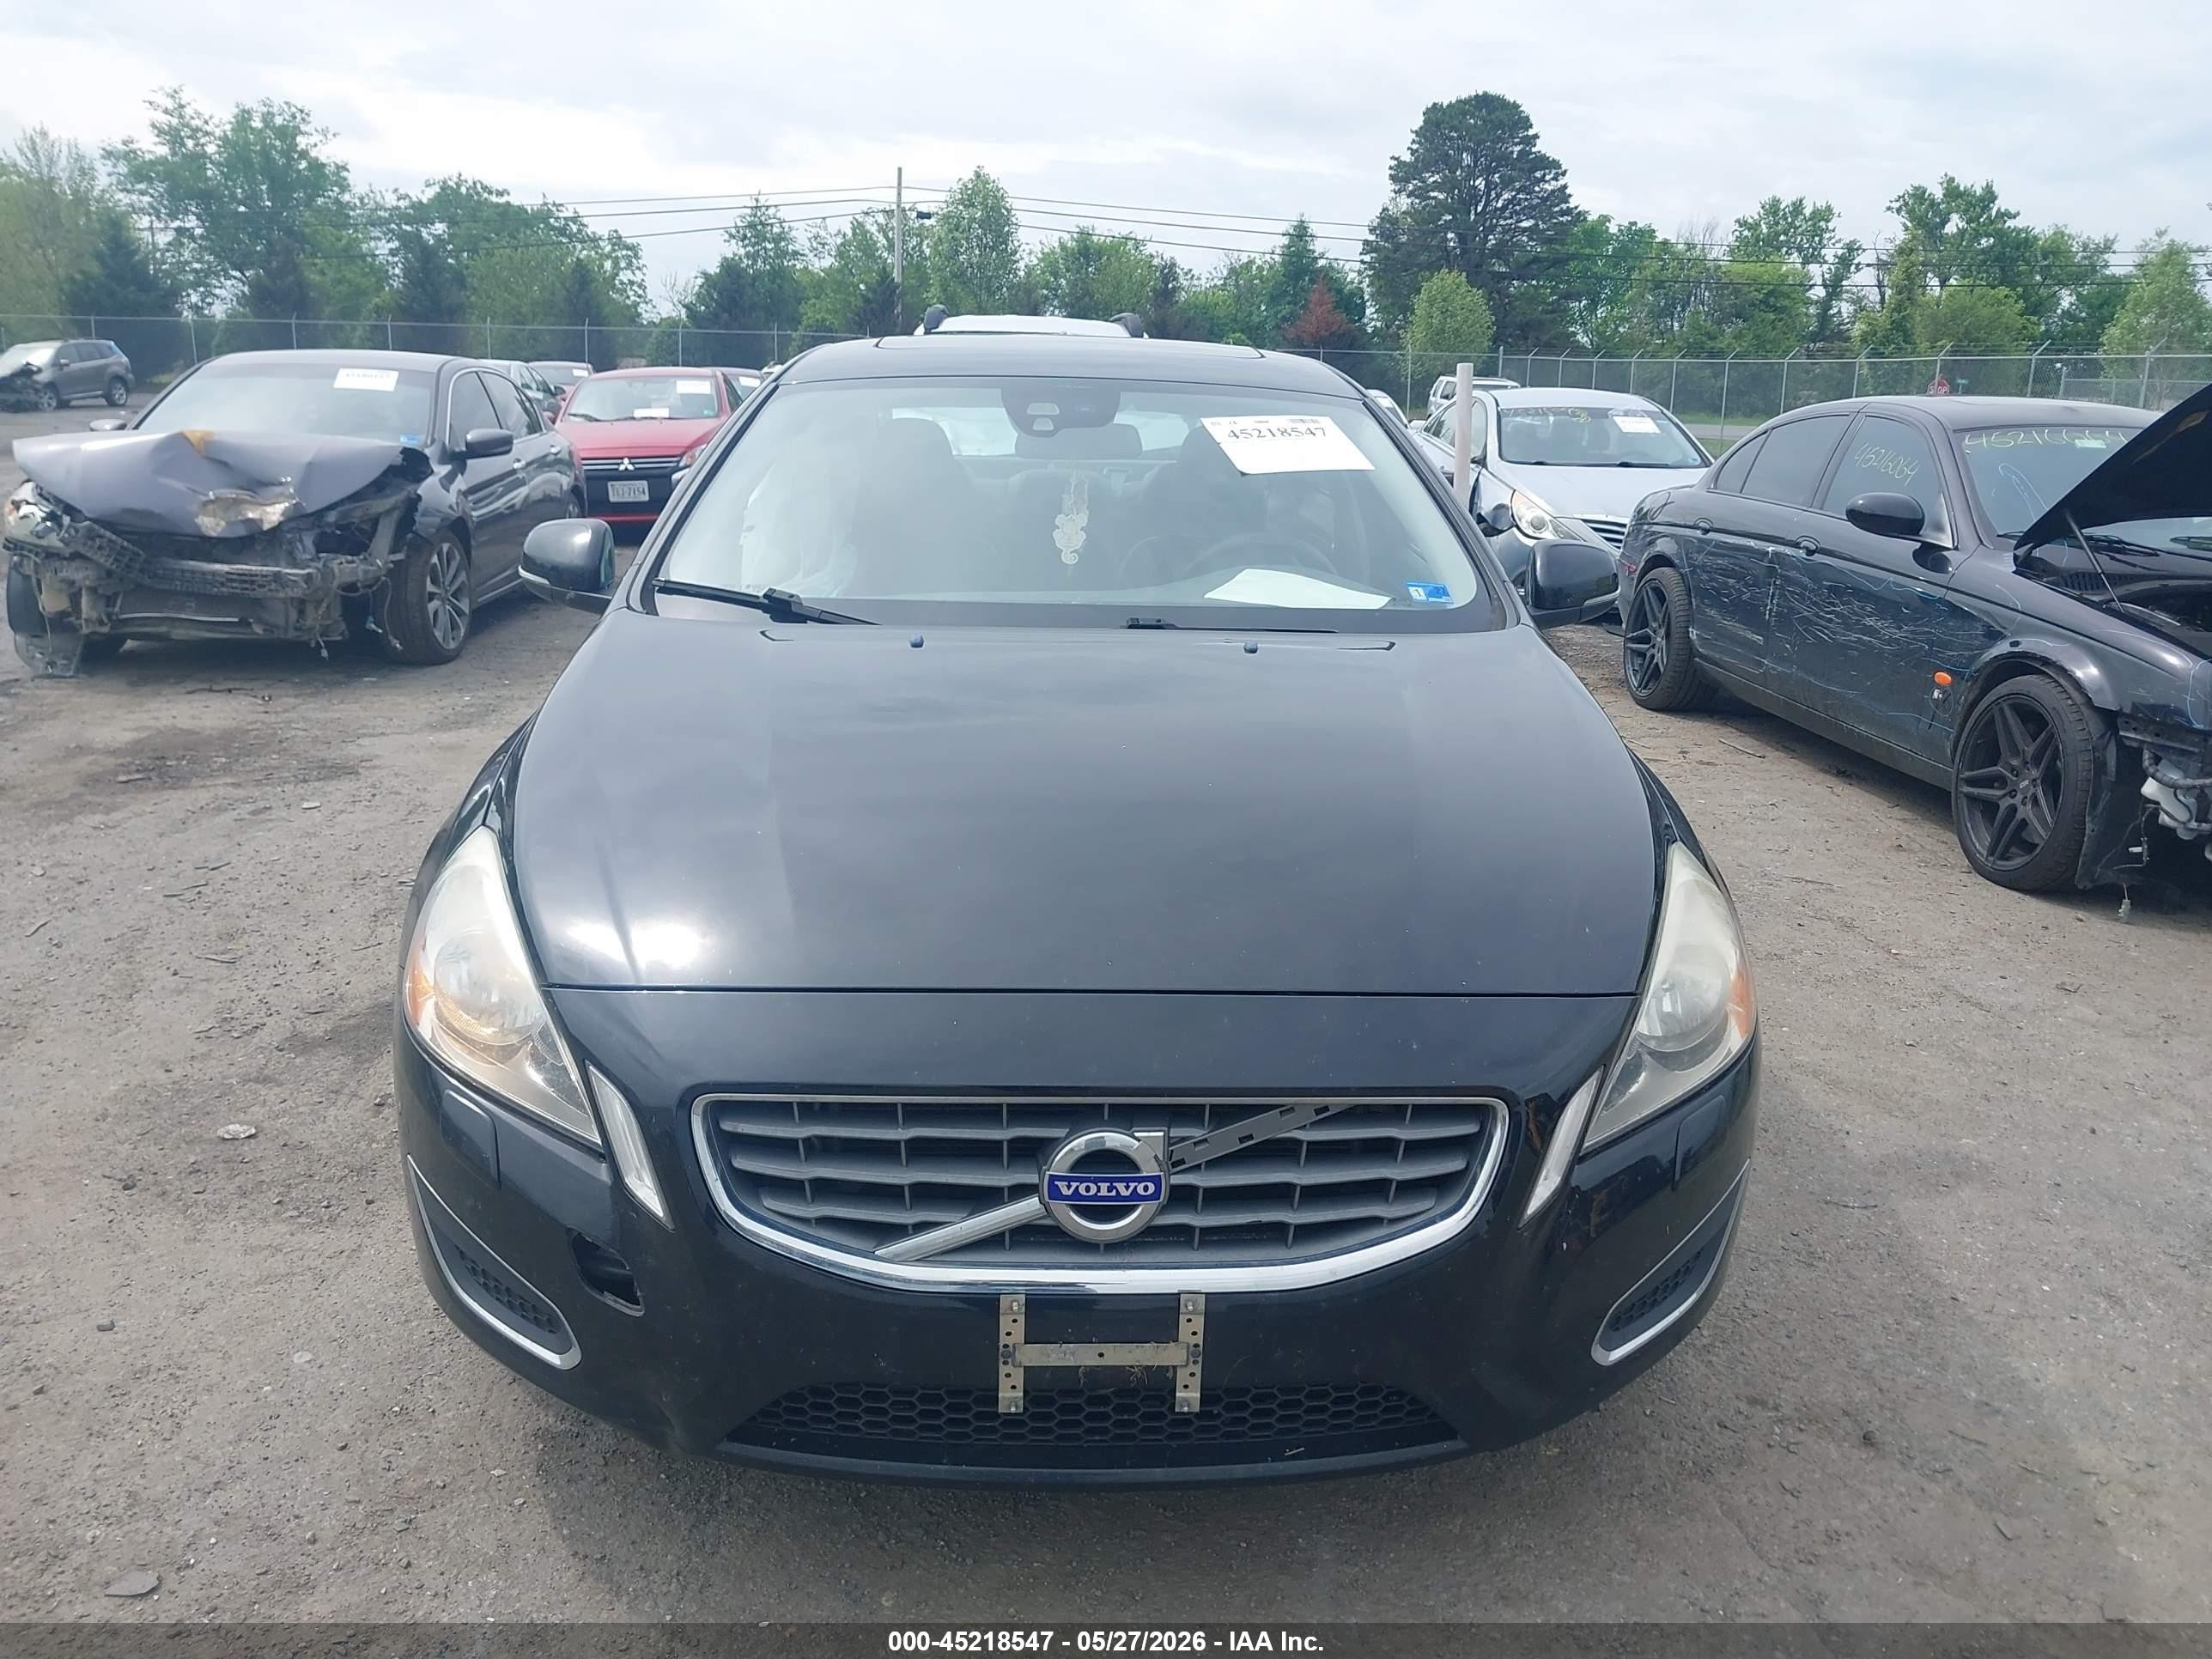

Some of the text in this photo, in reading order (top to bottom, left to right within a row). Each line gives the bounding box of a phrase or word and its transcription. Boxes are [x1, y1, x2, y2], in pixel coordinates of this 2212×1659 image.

[1929, 385, 1948, 393] SOP
[1227, 426, 1327, 440] 45218547
[1054, 1182, 1155, 1196] VOLVO
